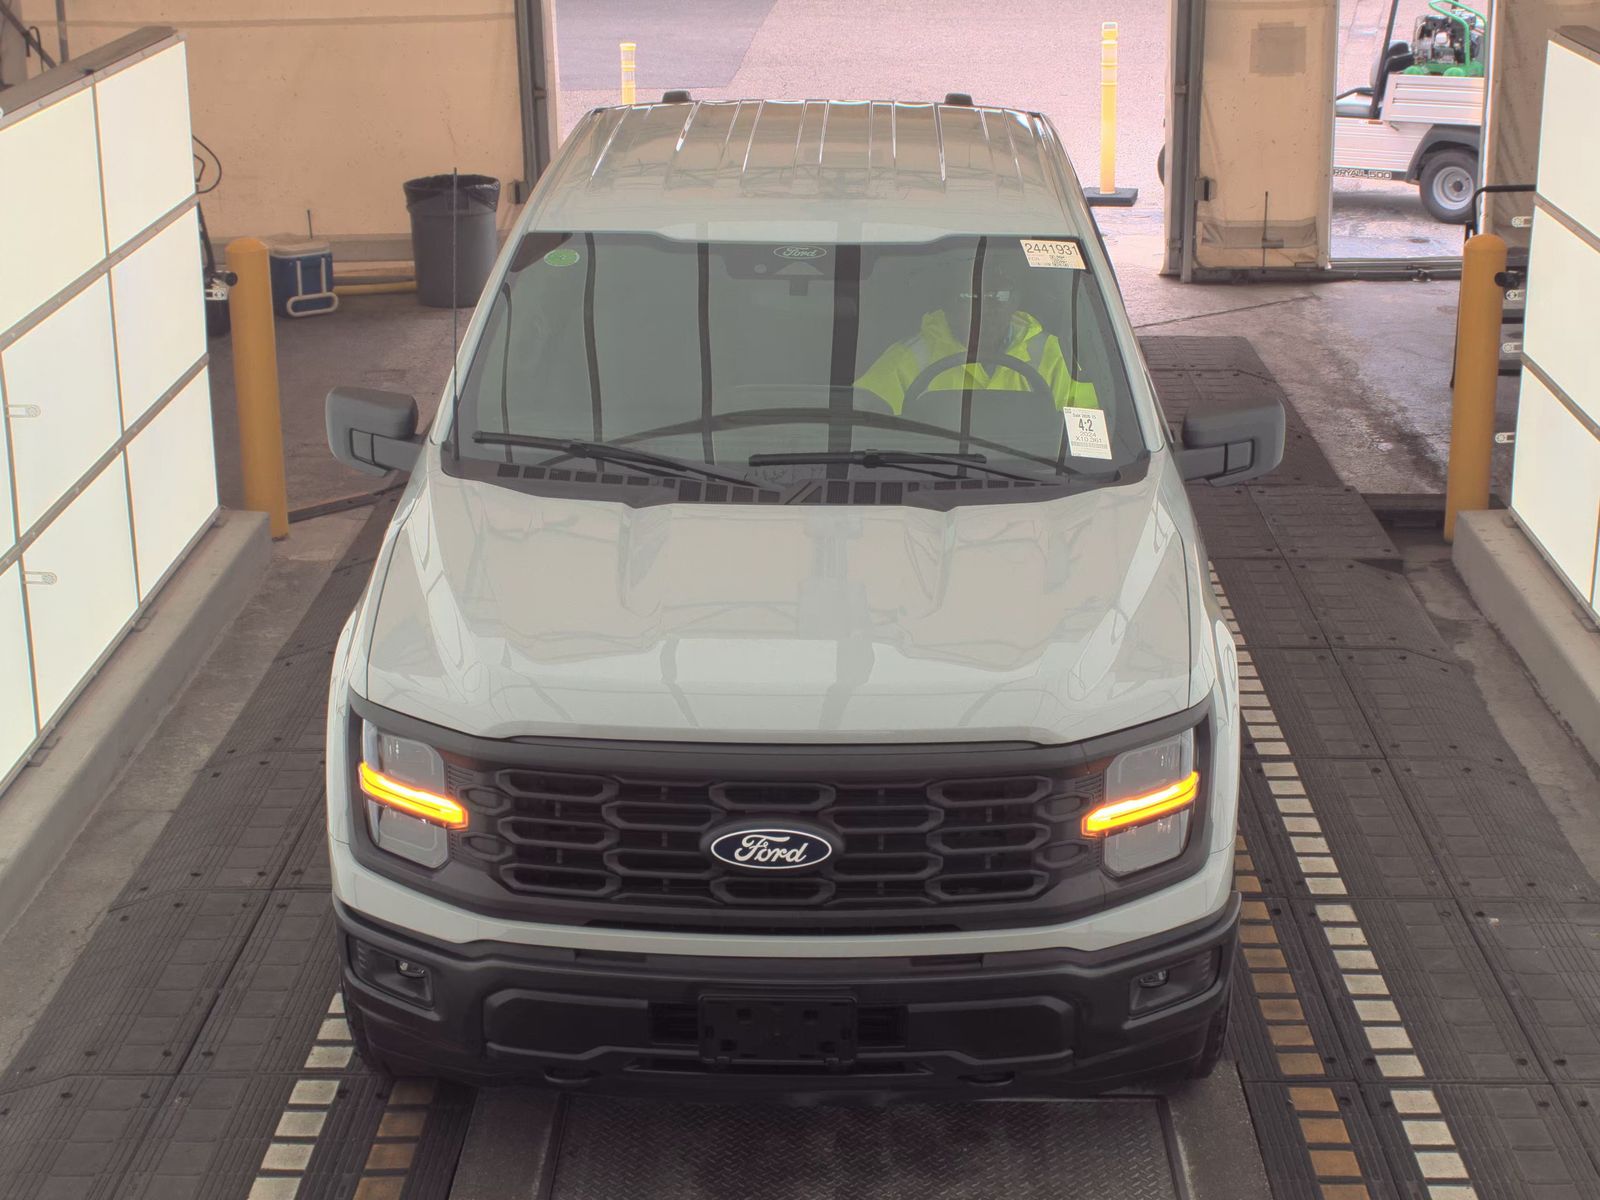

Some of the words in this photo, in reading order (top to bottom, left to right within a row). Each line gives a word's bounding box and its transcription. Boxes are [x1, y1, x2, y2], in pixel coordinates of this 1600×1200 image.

[1333, 168, 1368, 177] RRYALL
[783, 247, 817, 257] Ford
[1025, 243, 1078, 255] 2441931
[1078, 418, 1094, 432] 4:2
[734, 834, 809, 862] Ford
